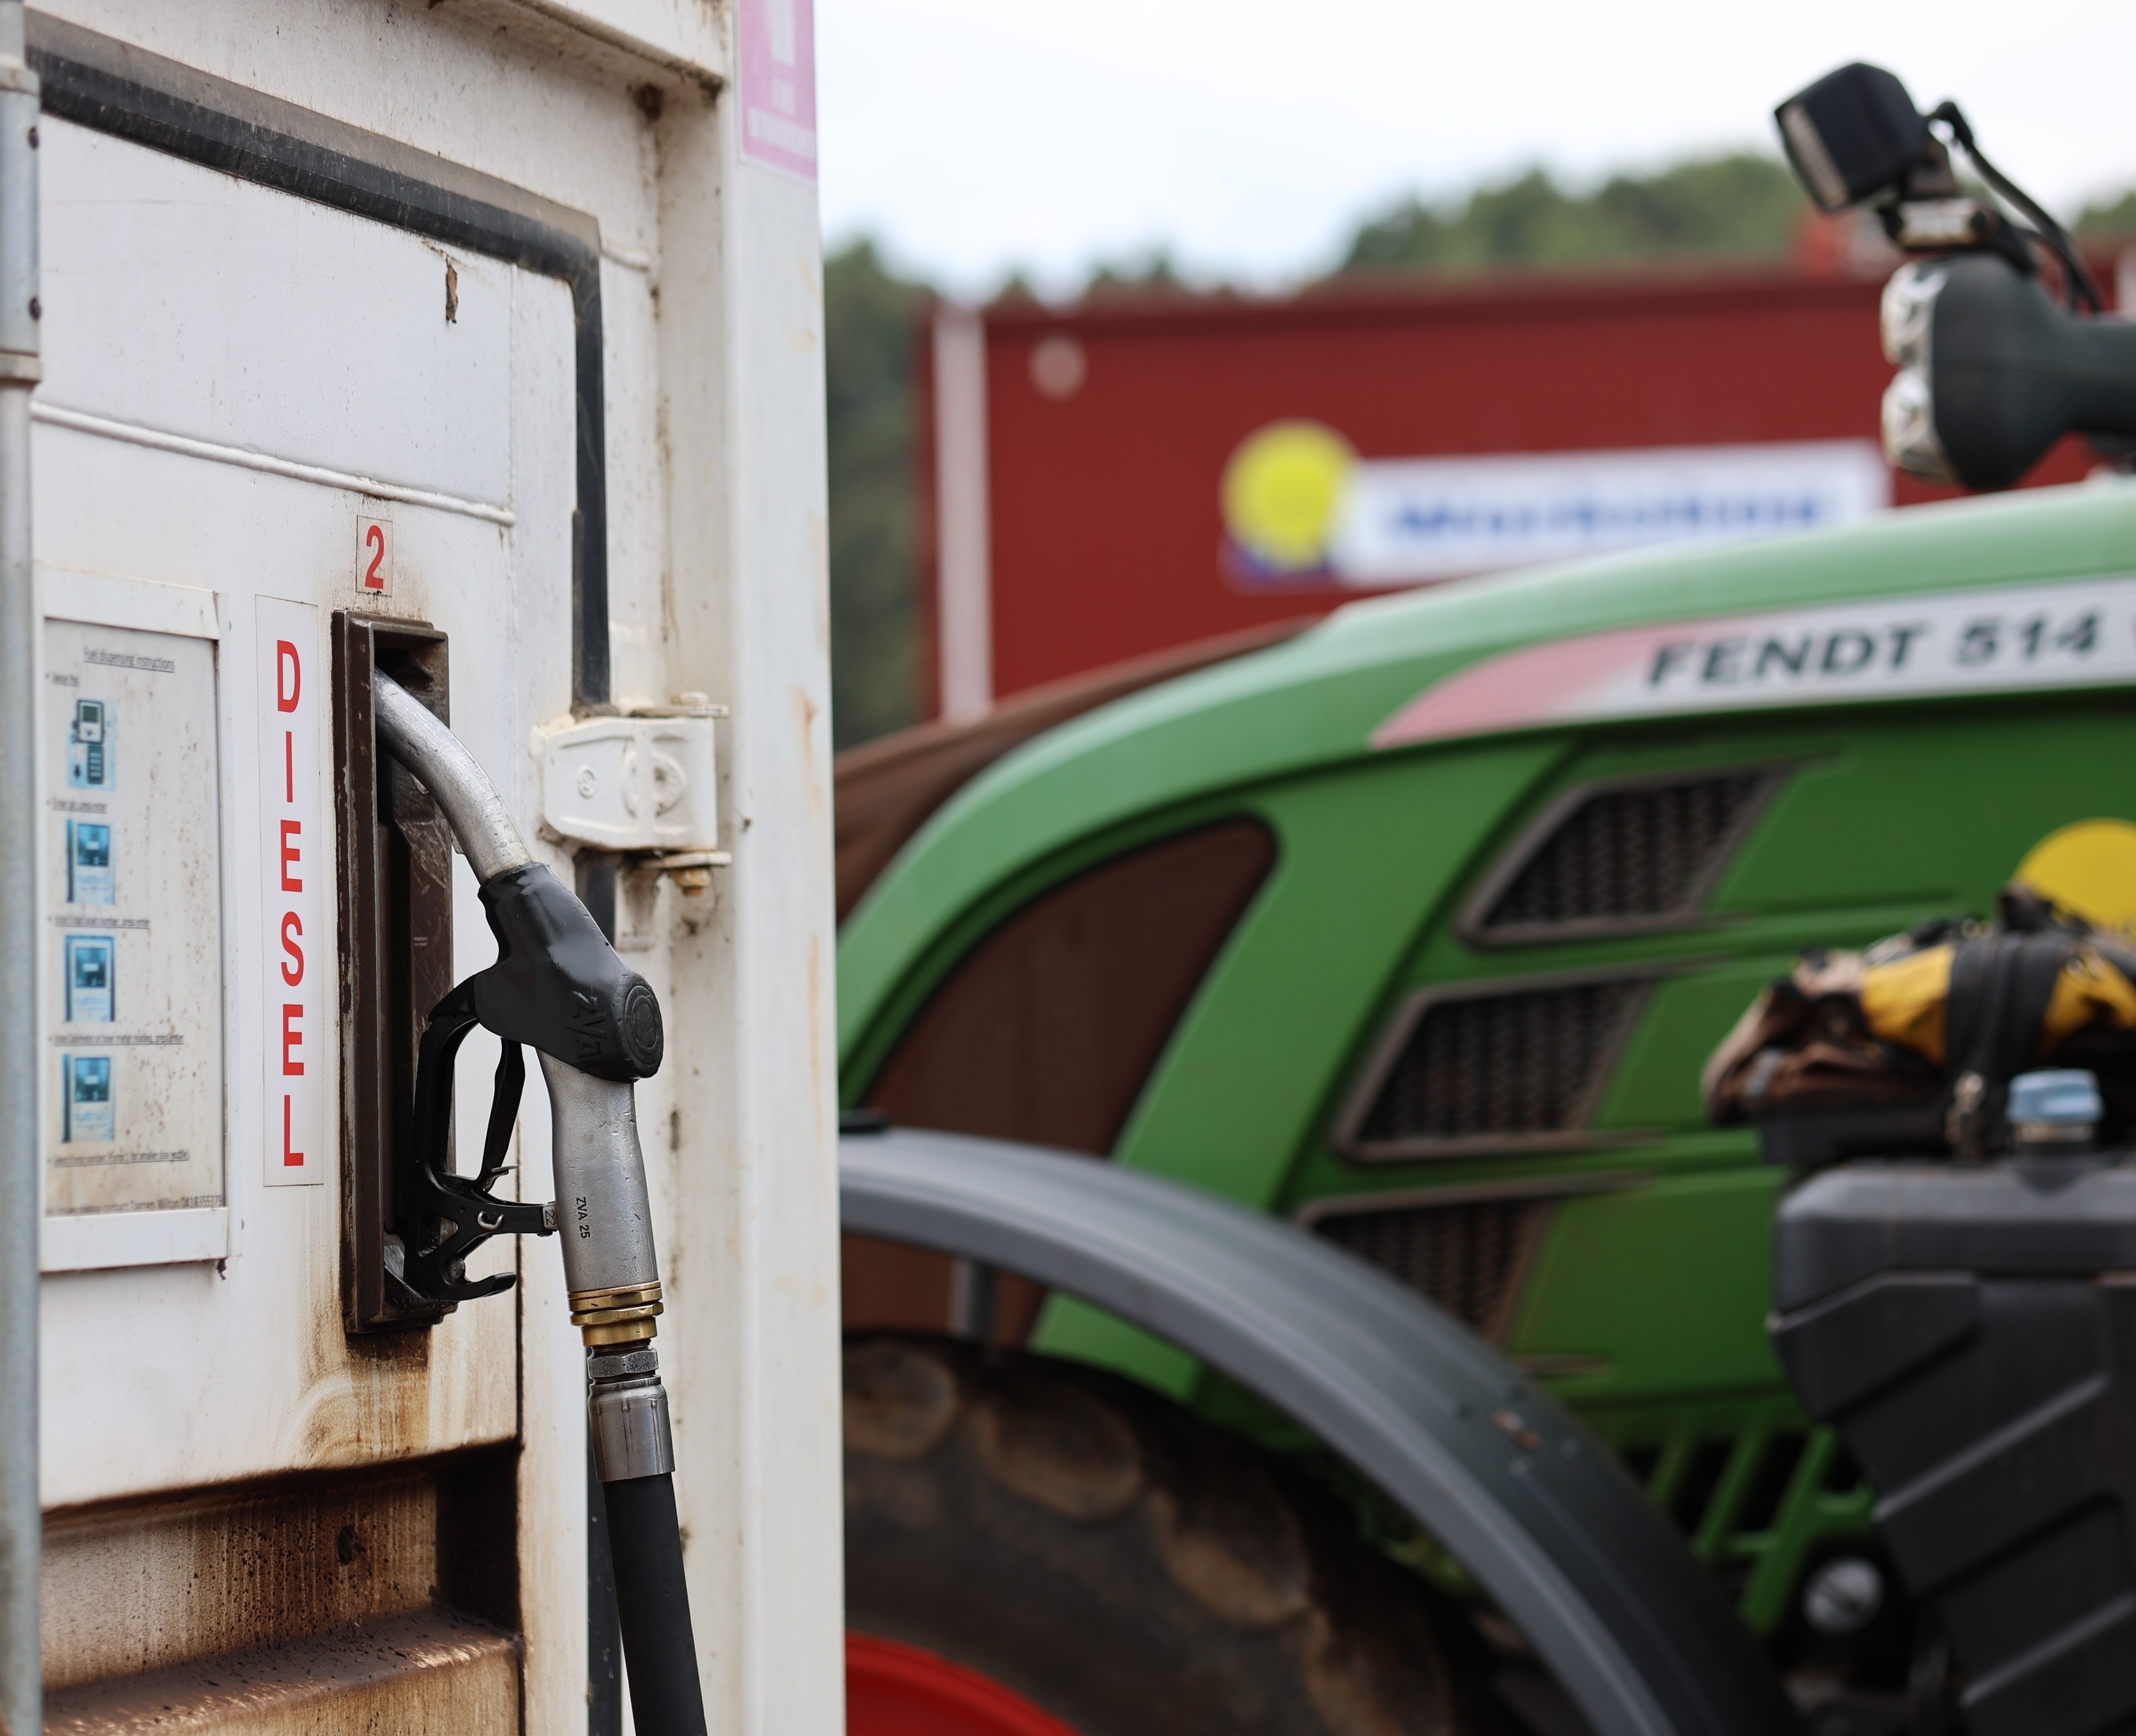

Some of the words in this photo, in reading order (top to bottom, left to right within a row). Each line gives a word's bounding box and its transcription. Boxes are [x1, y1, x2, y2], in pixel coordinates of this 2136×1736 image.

[365, 525, 385, 590] 2
[84, 646, 98, 661] Fuel
[100, 648, 134, 668] dispensing
[137, 654, 175, 671] instructions
[1647, 618, 1929, 687] FENDT
[1957, 606, 2105, 669] 514
[277, 639, 305, 1166] DIESEL
[544, 1209, 556, 1226] 22
[576, 1197, 589, 1221] ZVA
[579, 1224, 592, 1239] 25
